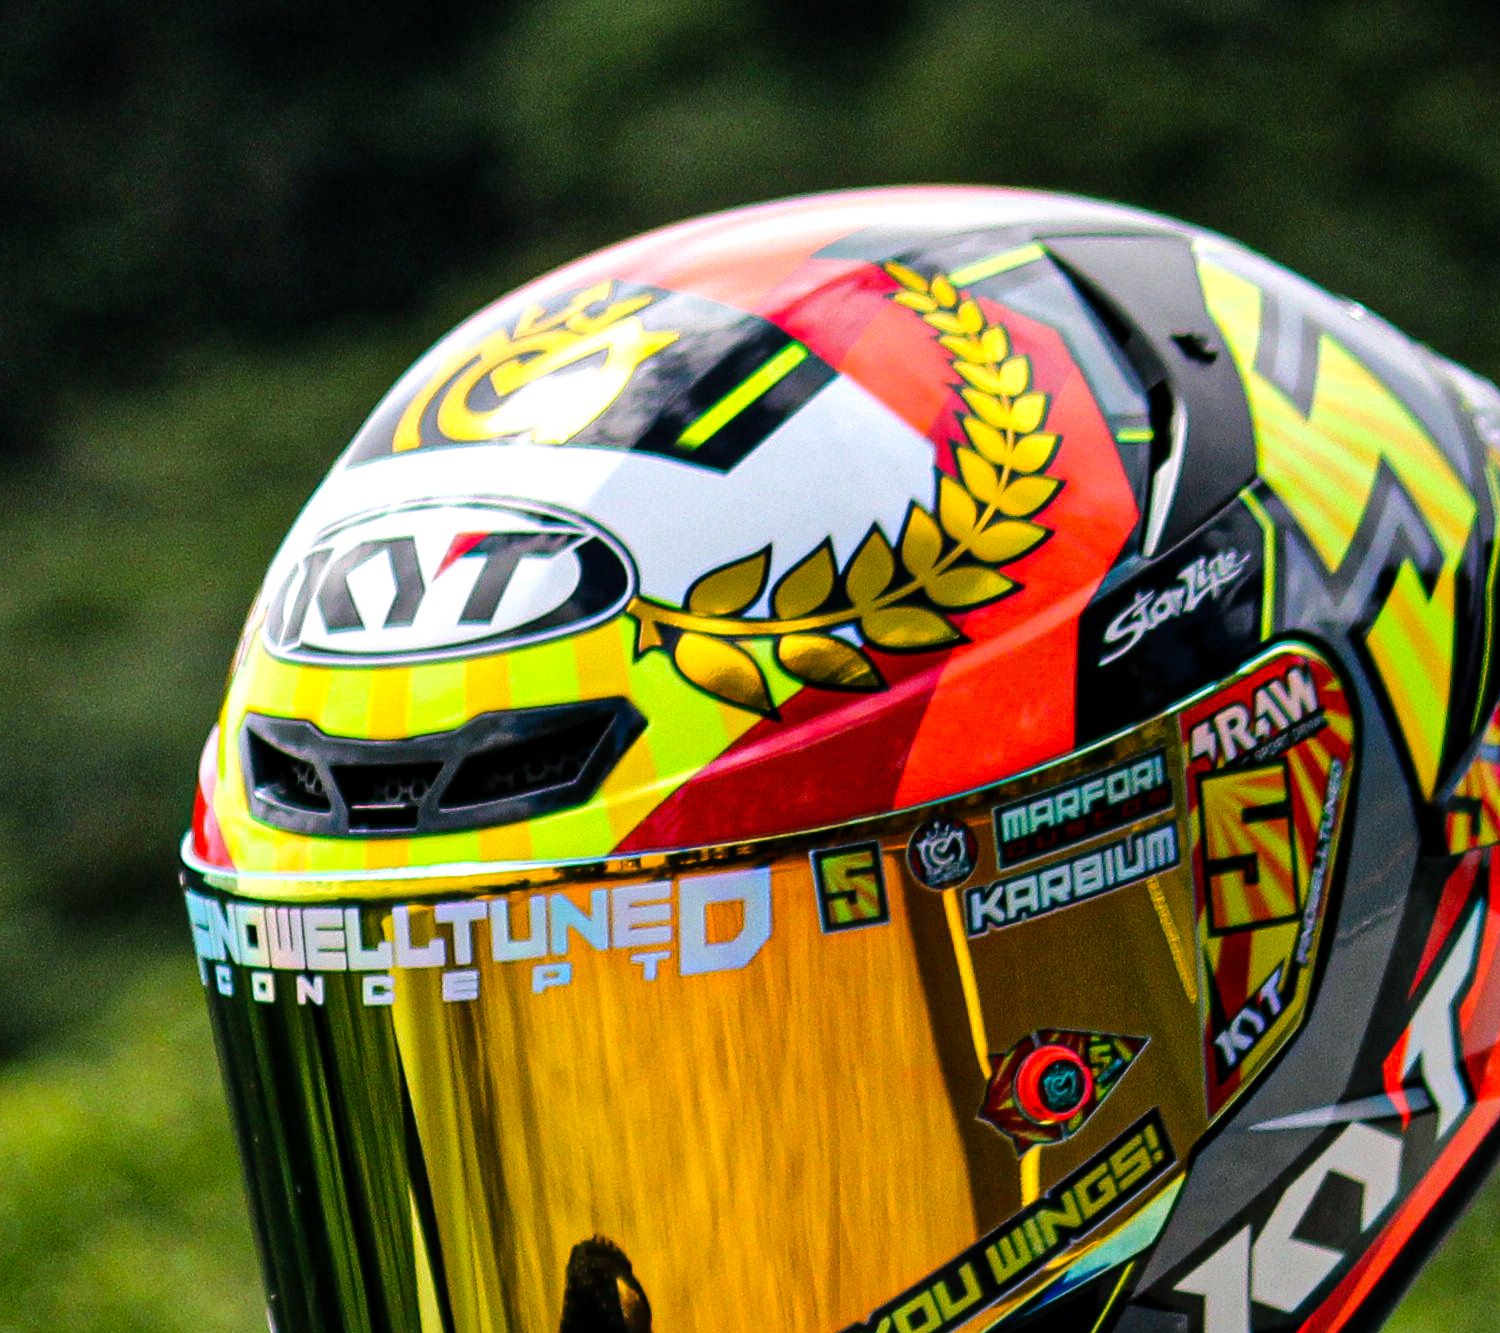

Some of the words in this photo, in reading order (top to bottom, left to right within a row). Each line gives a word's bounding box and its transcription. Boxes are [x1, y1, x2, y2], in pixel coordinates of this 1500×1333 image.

[281, 532, 594, 650] KYT
[1001, 754, 1164, 843] MARFORI
[820, 850, 880, 924] 5
[970, 826, 1177, 931] KARBIUM
[215, 950, 672, 1006] CONCEPT
[1213, 968, 1284, 1066] KYT
[995, 1122, 1167, 1285] WINGS!
